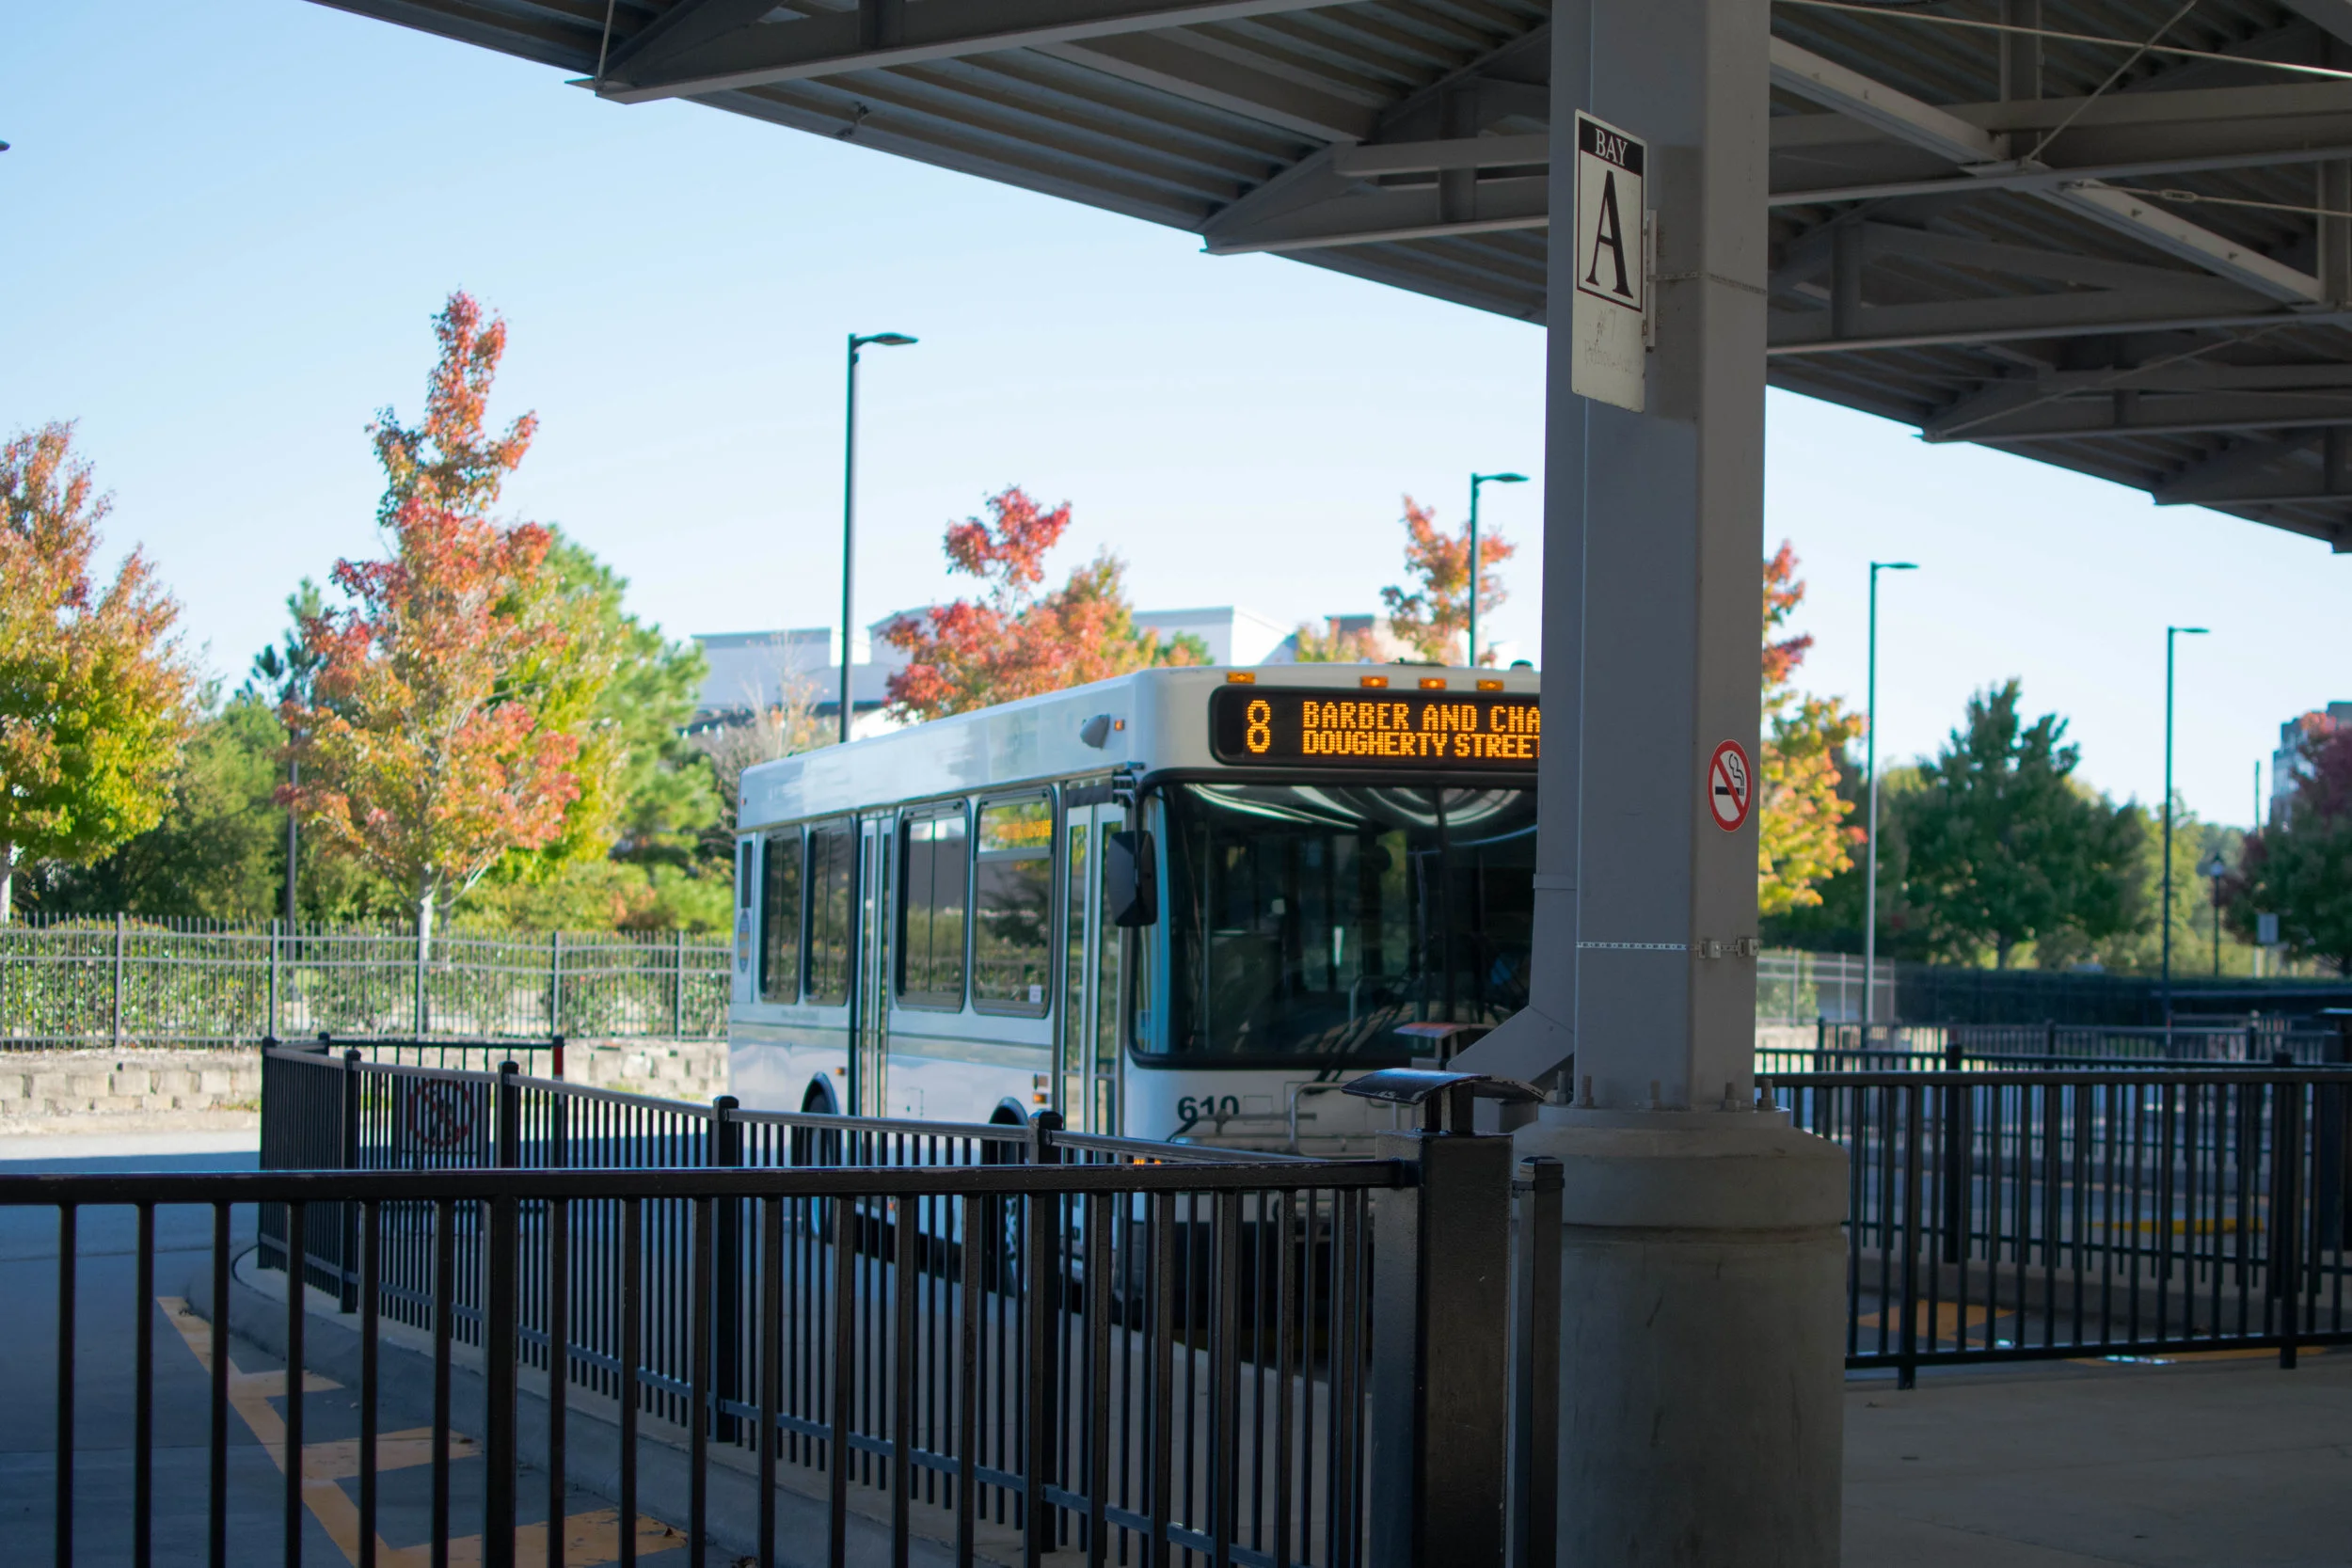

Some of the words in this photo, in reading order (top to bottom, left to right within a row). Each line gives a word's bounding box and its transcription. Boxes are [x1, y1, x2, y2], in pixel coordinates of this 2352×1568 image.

[1595, 127, 1628, 166] BAY
[1584, 168, 1634, 300] A
[1247, 699, 1272, 754] 8
[1302, 700, 1410, 731] BARBER
[1422, 703, 1478, 733] AND
[1489, 705, 1541, 734] CHA
[1302, 729, 1449, 756] DOUGHERTY
[1177, 1094, 1240, 1123] 610
